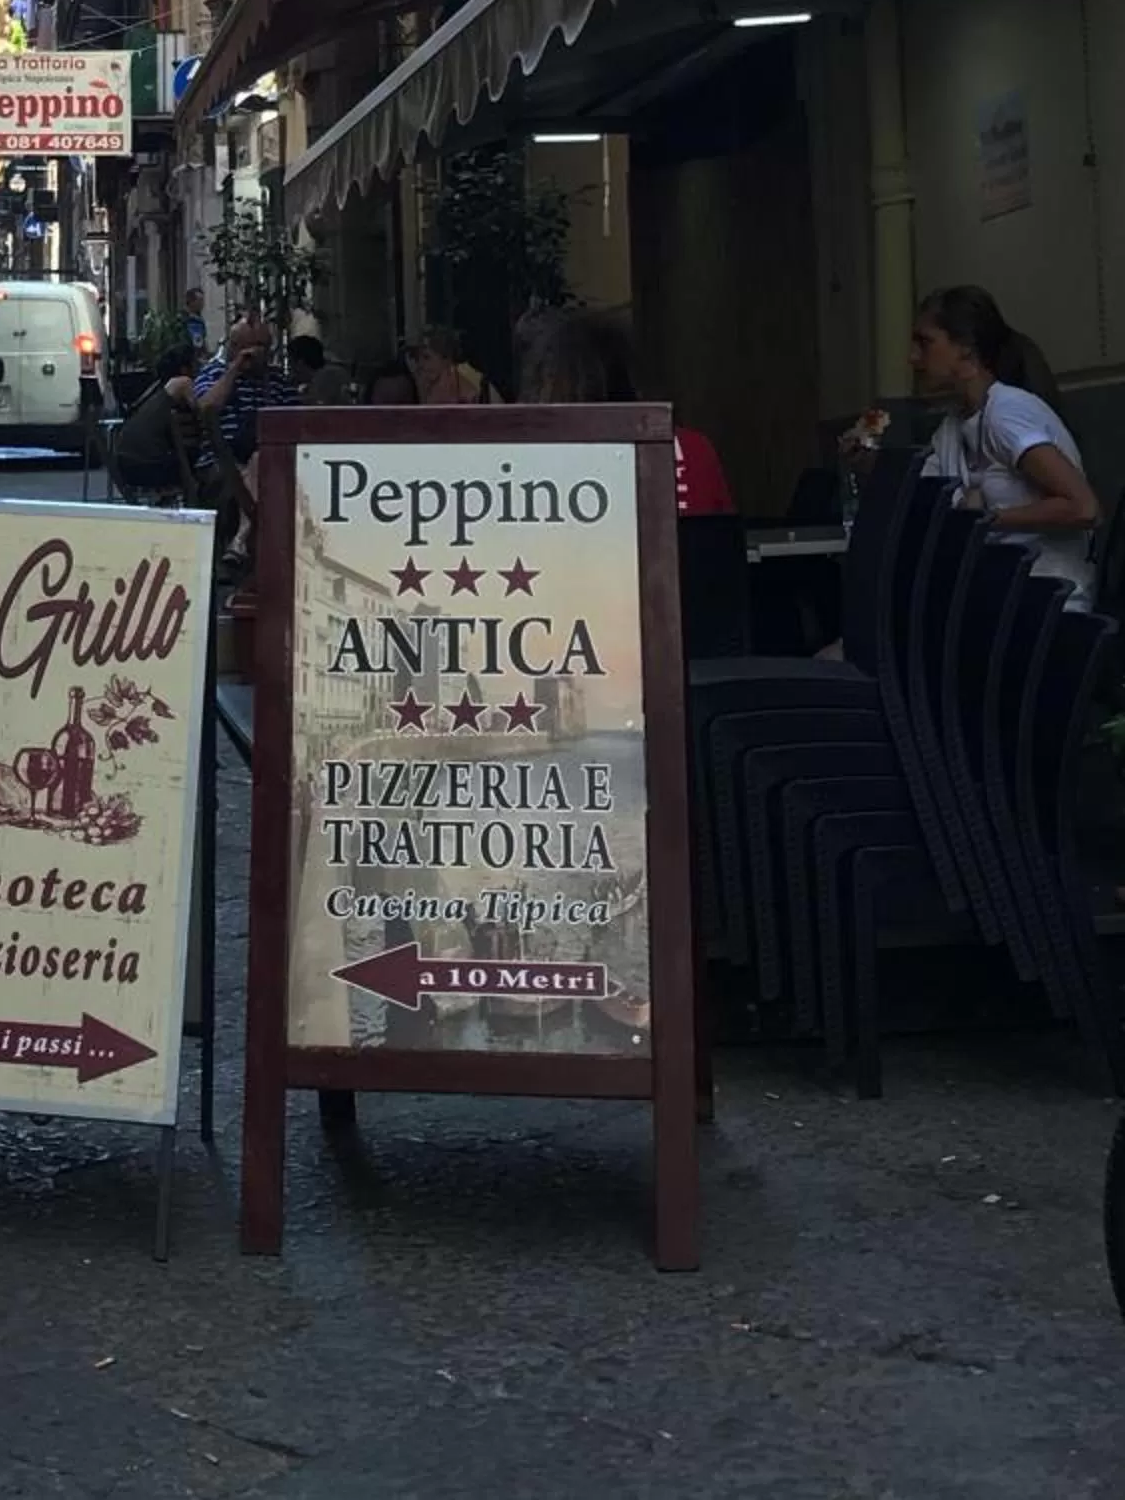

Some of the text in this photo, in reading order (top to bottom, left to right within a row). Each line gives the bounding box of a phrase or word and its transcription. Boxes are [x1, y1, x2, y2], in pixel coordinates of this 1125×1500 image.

[14, 55, 85, 71] Trattoria
[6, 136, 40, 150] 081
[48, 136, 121, 150] 407649
[323, 460, 609, 546] Peppino
[328, 616, 606, 676] ANTICA
[324, 760, 613, 811] PIZZERIA E
[322, 818, 617, 871] TRATTORIA
[325, 886, 612, 931] Cucina Tipica
[419, 967, 596, 991] a 10 Metri
